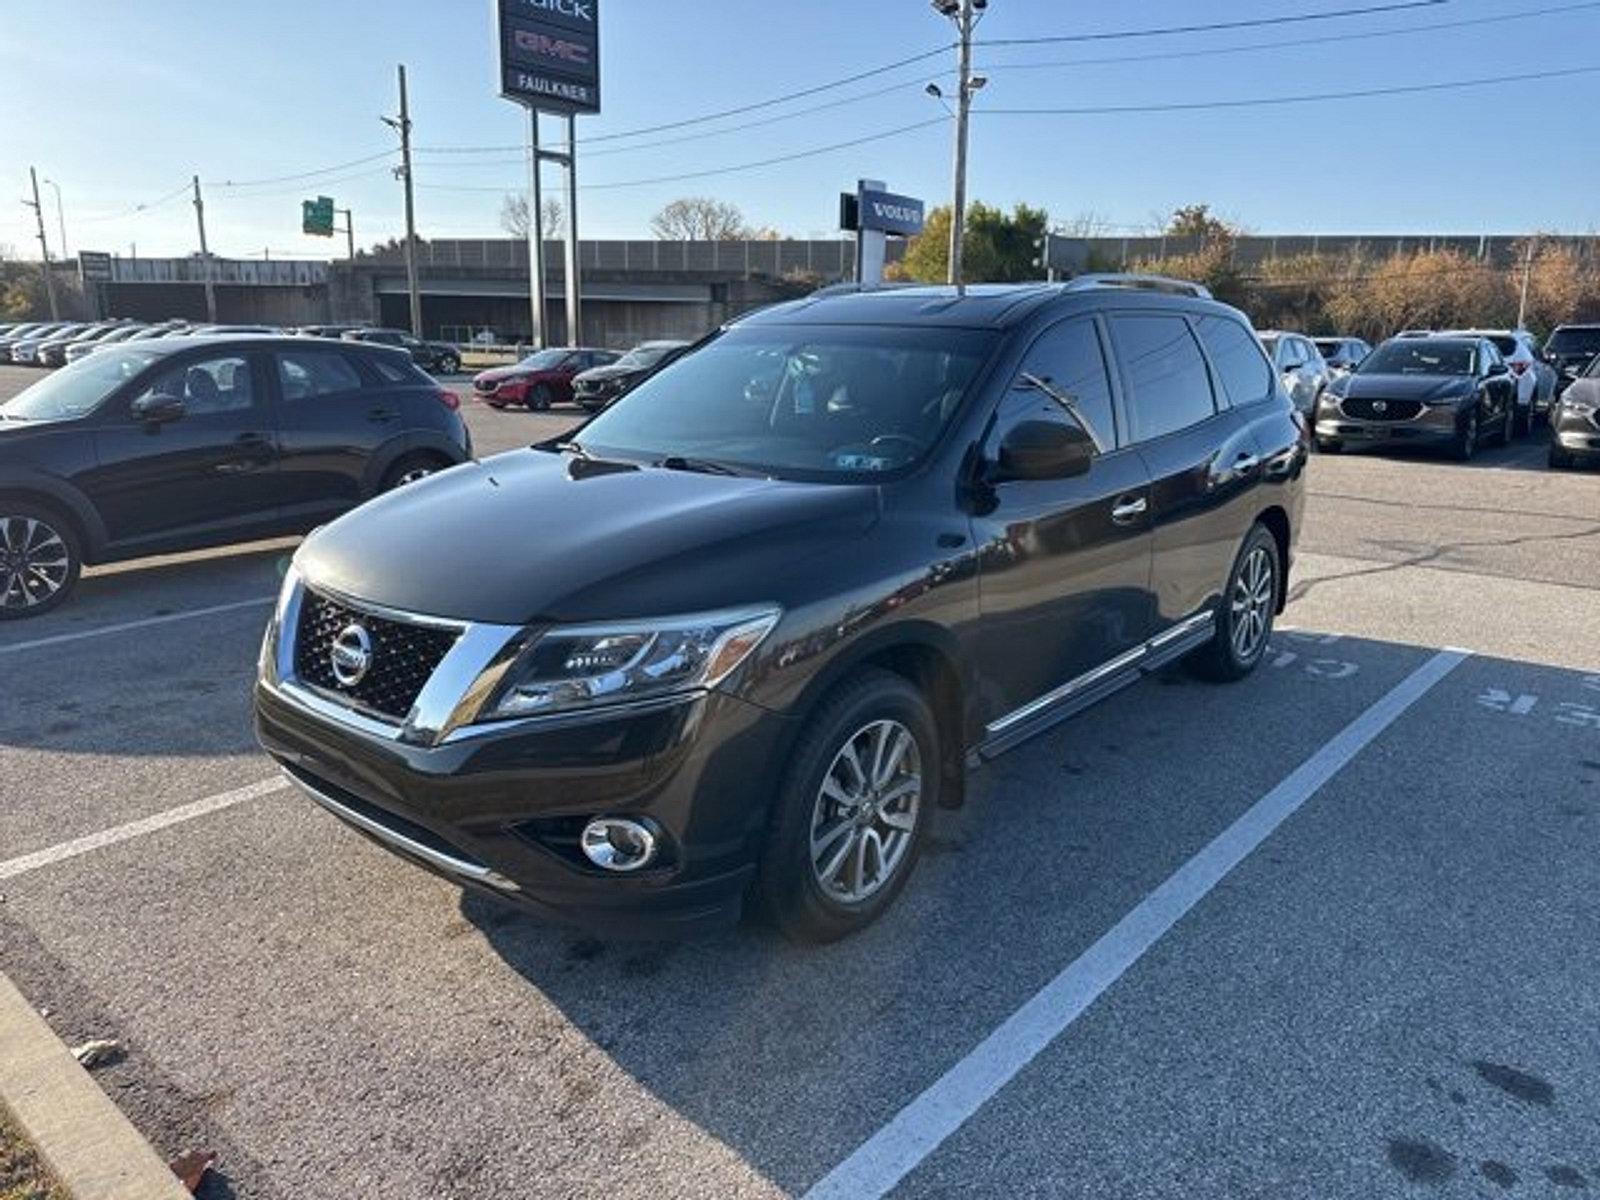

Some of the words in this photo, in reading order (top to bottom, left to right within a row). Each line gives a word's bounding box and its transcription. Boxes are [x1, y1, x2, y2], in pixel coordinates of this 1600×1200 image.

[521, 0, 592, 21] ICK
[515, 30, 589, 63] GMC
[519, 74, 587, 100] FAULKNER
[872, 201, 919, 224] VOLVO
